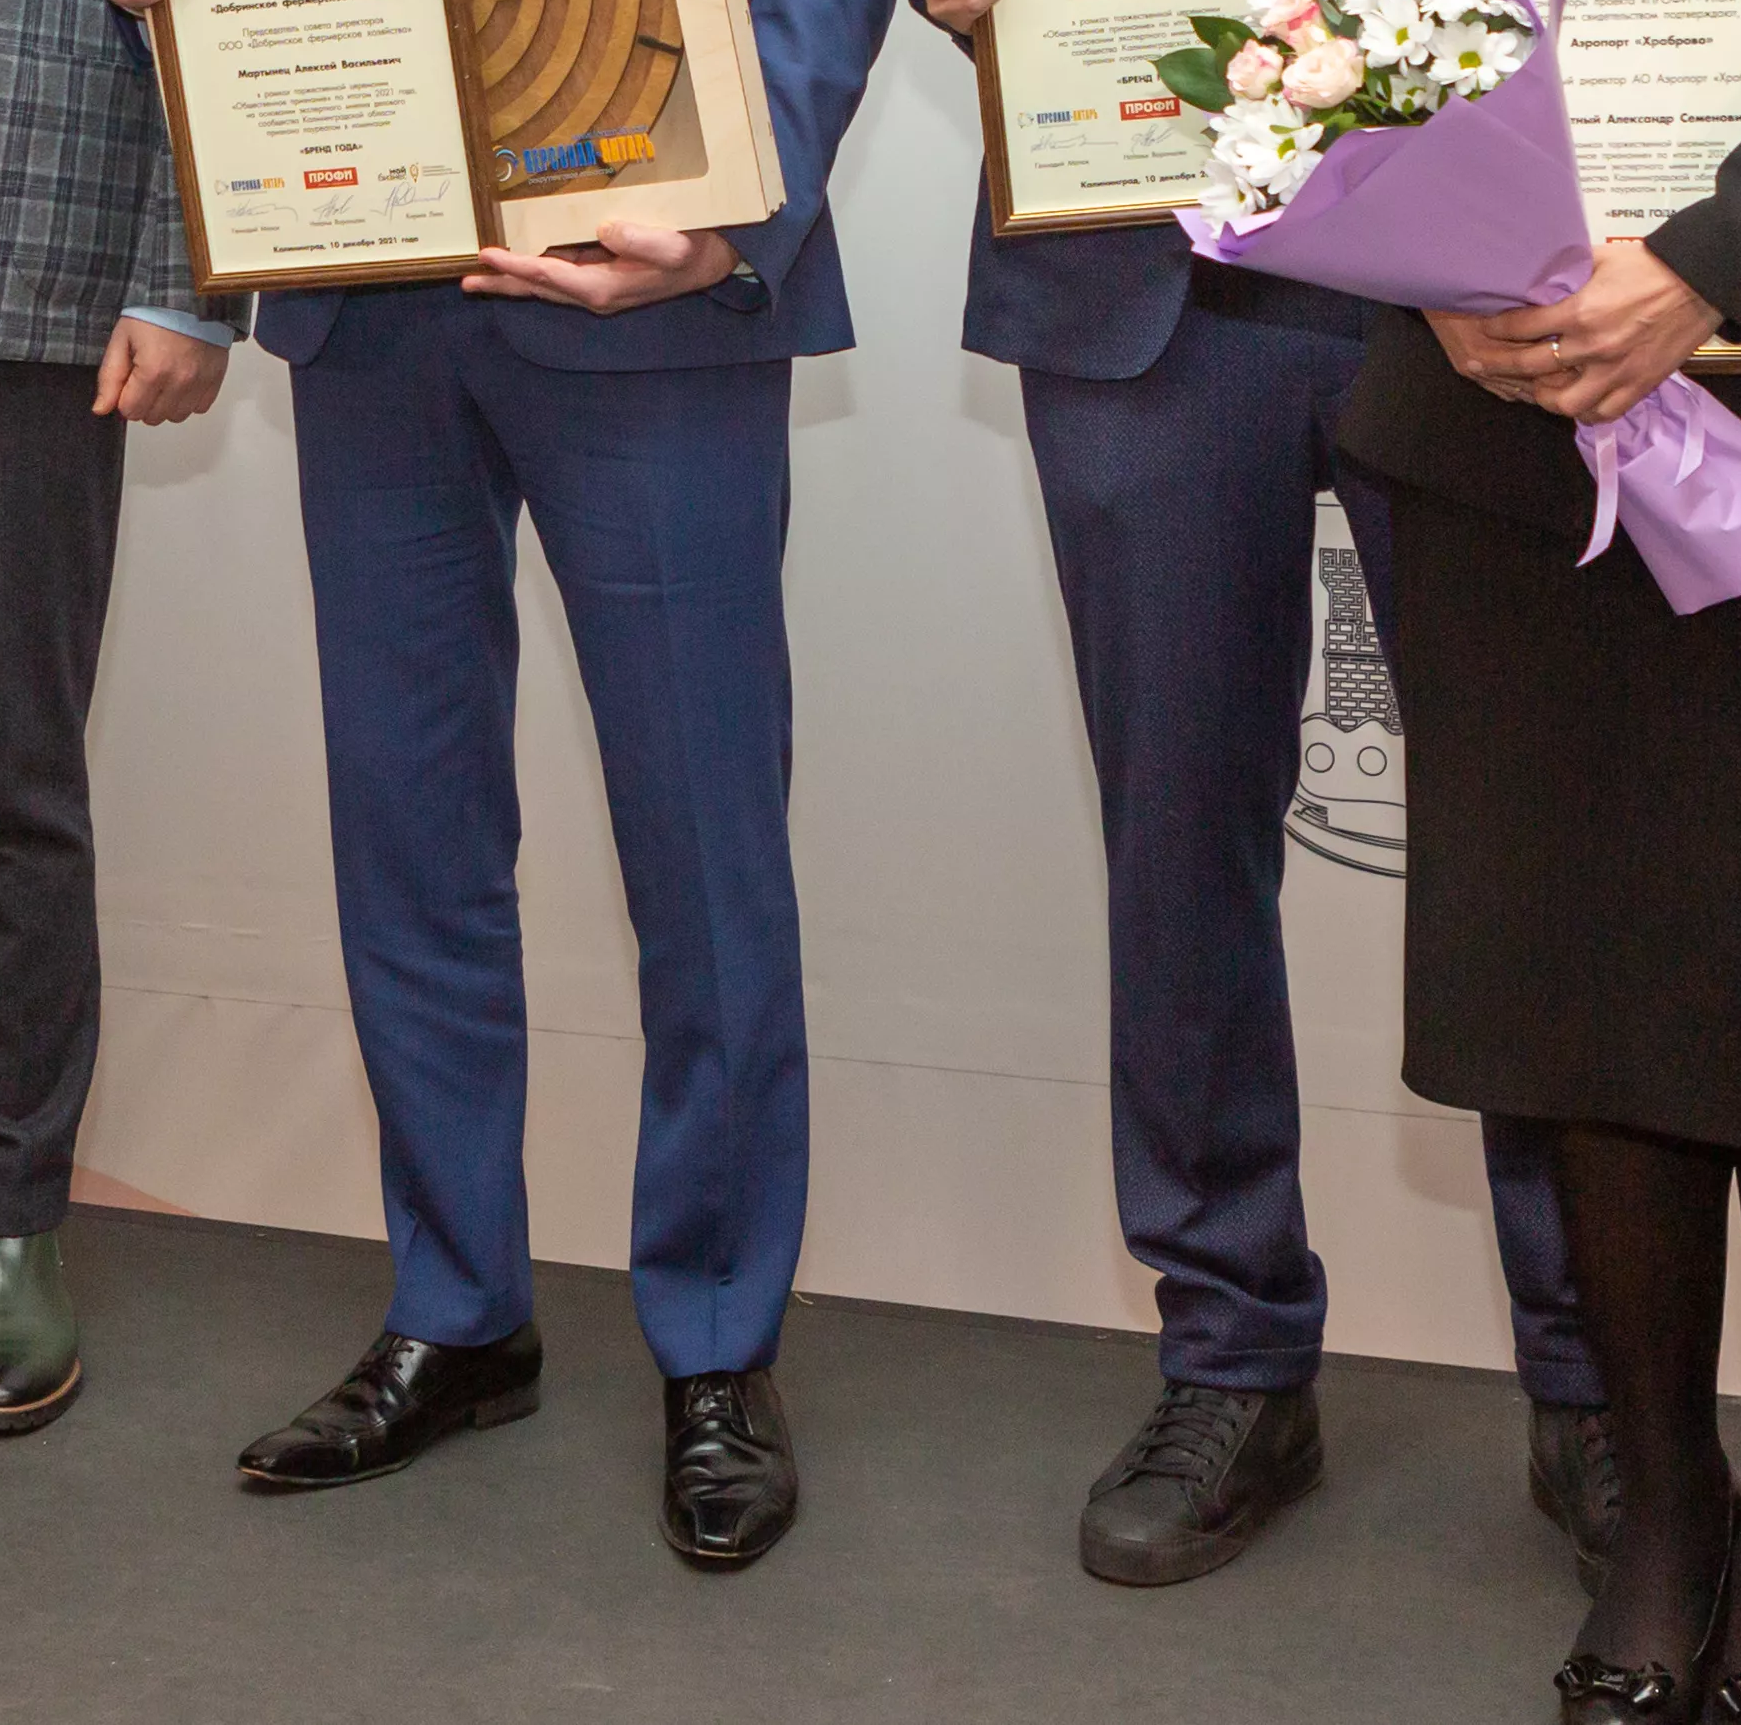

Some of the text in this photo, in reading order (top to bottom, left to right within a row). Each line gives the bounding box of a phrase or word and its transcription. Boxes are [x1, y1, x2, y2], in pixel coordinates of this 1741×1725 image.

[210, 0, 277, 14] «Добринское
[1570, 34, 1713, 50] Аэропорт «Храброво»
[237, 57, 401, 79] Мартынец Алексей Васильевич
[1124, 99, 1176, 116] ПРОФИ
[1606, 114, 1674, 125] Александр
[308, 169, 353, 184] ПРОФИ
[1144, 174, 1156, 182] 10
